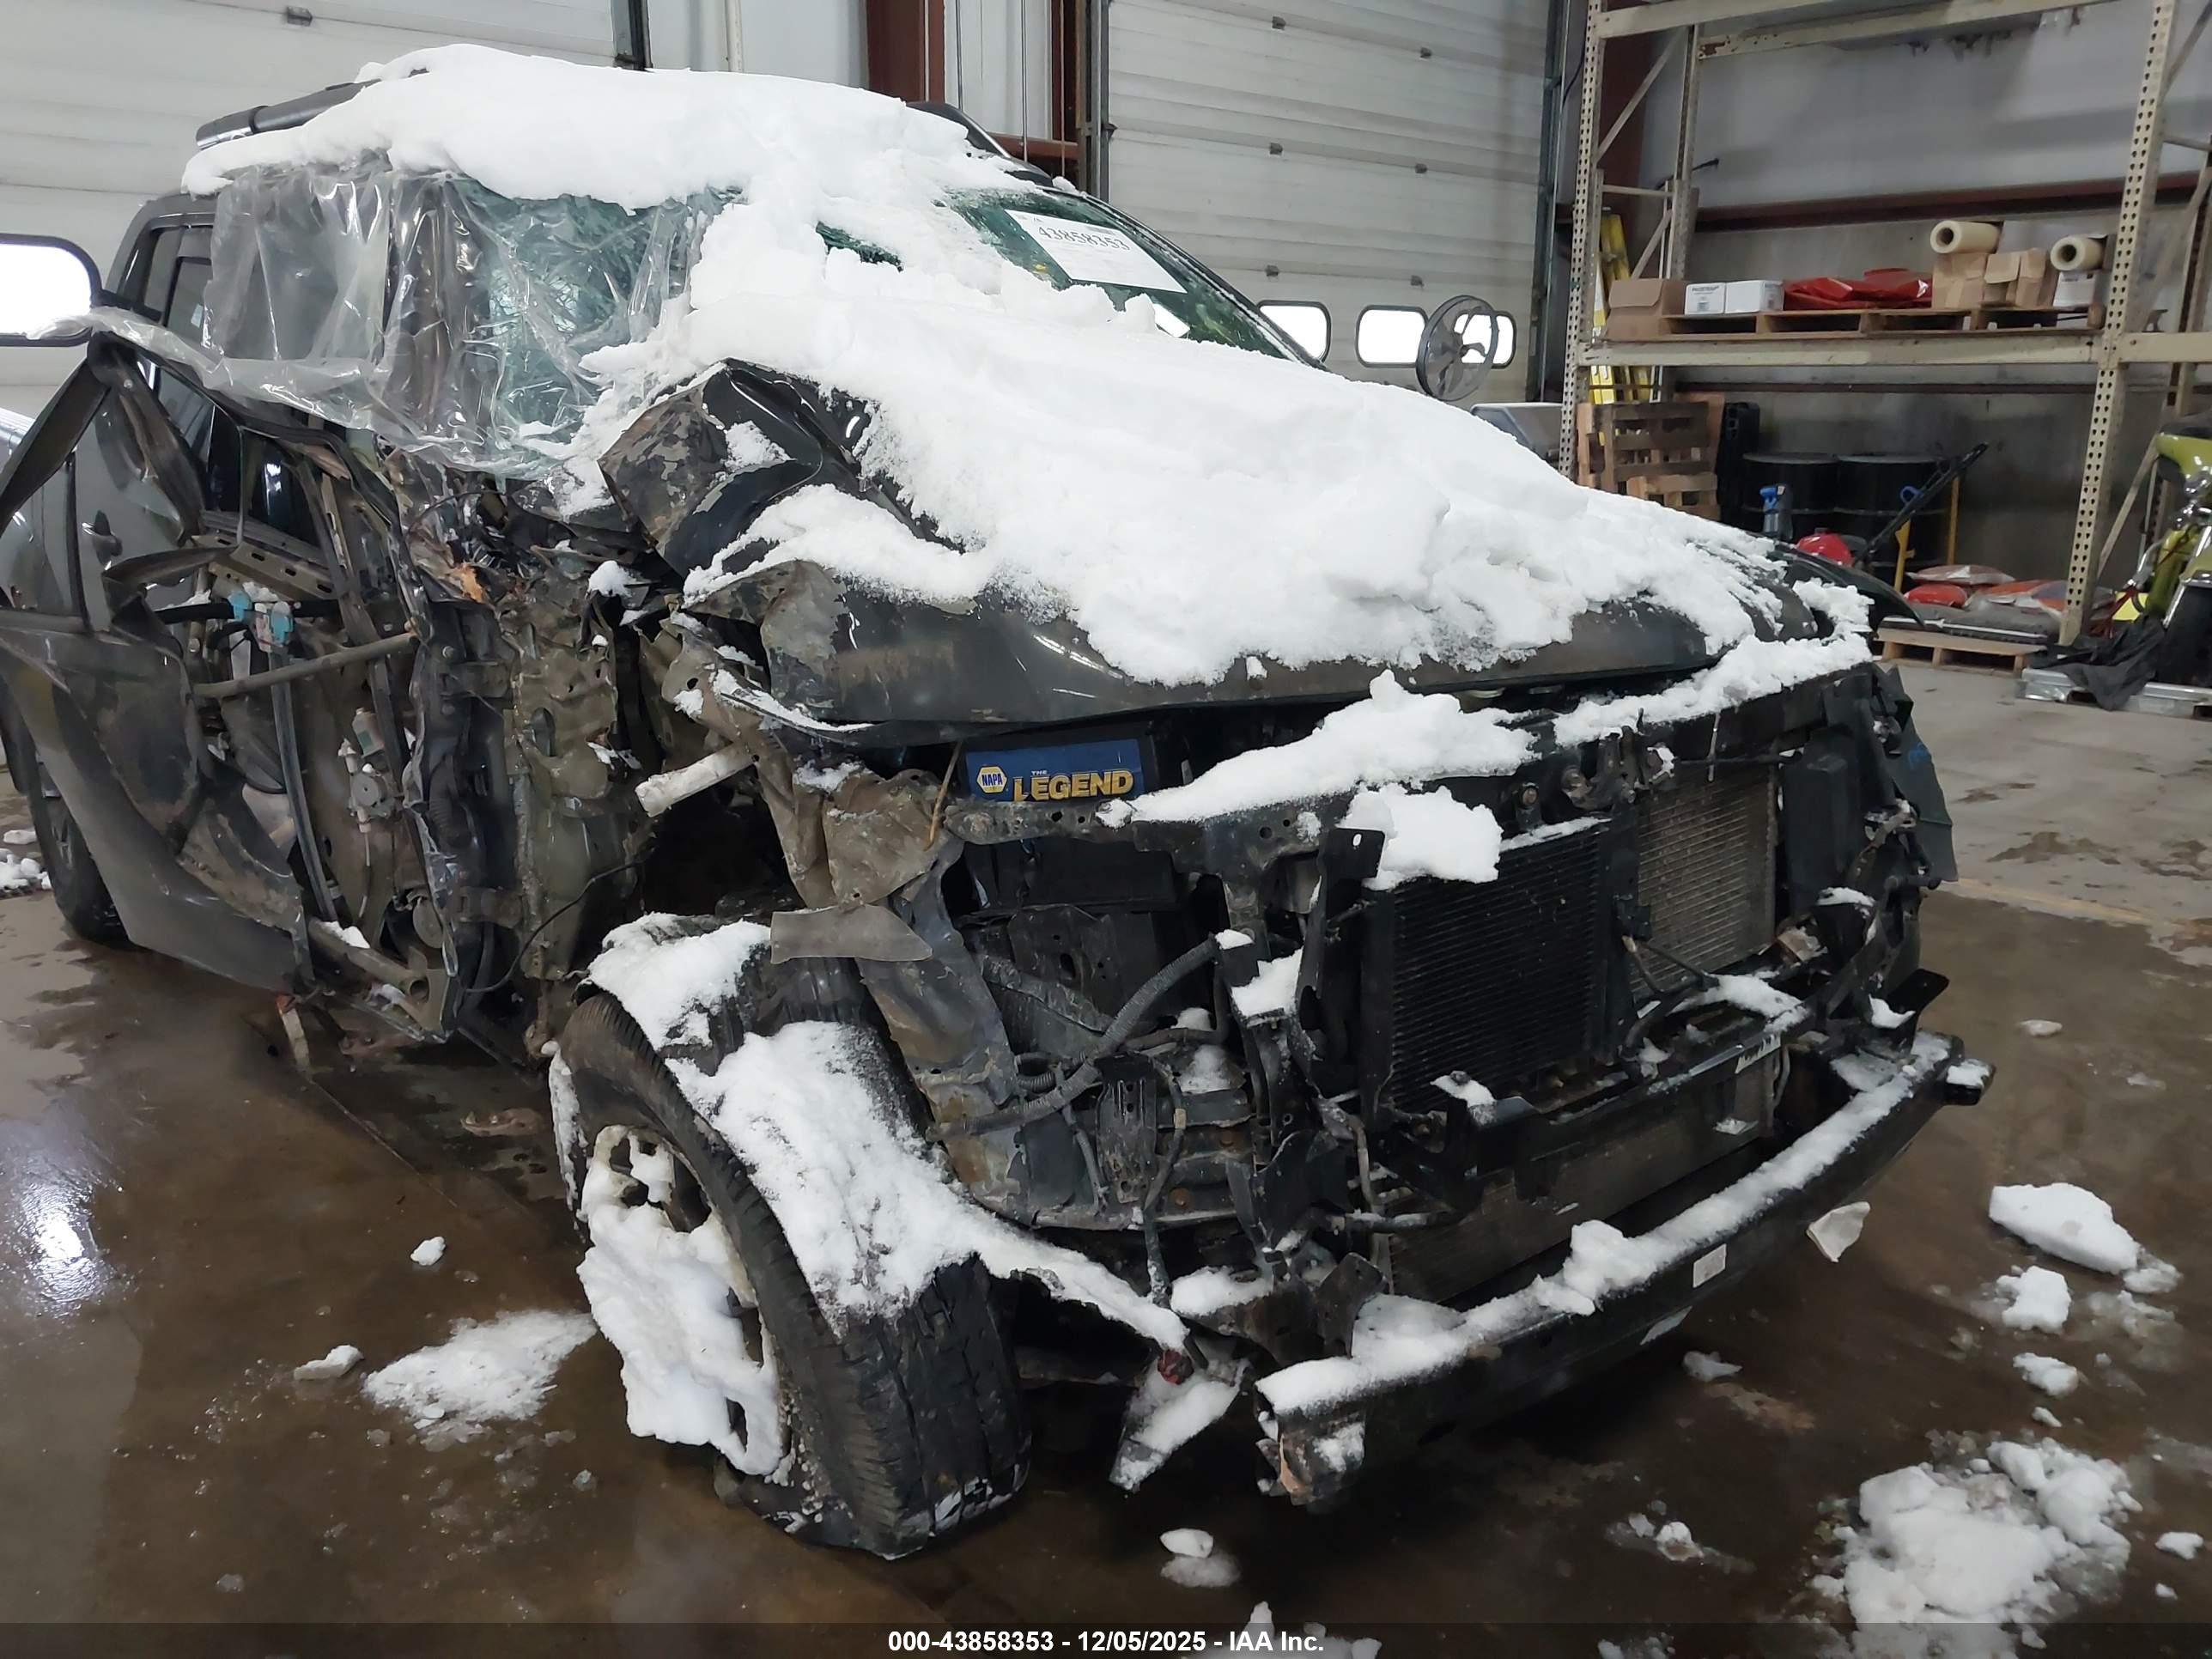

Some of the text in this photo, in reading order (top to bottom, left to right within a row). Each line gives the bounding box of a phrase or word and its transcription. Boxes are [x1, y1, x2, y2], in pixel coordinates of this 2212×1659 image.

[1039, 226, 1131, 251] 43858353
[981, 773, 1003, 787] NAPA
[1012, 769, 1134, 802] LEGEND
